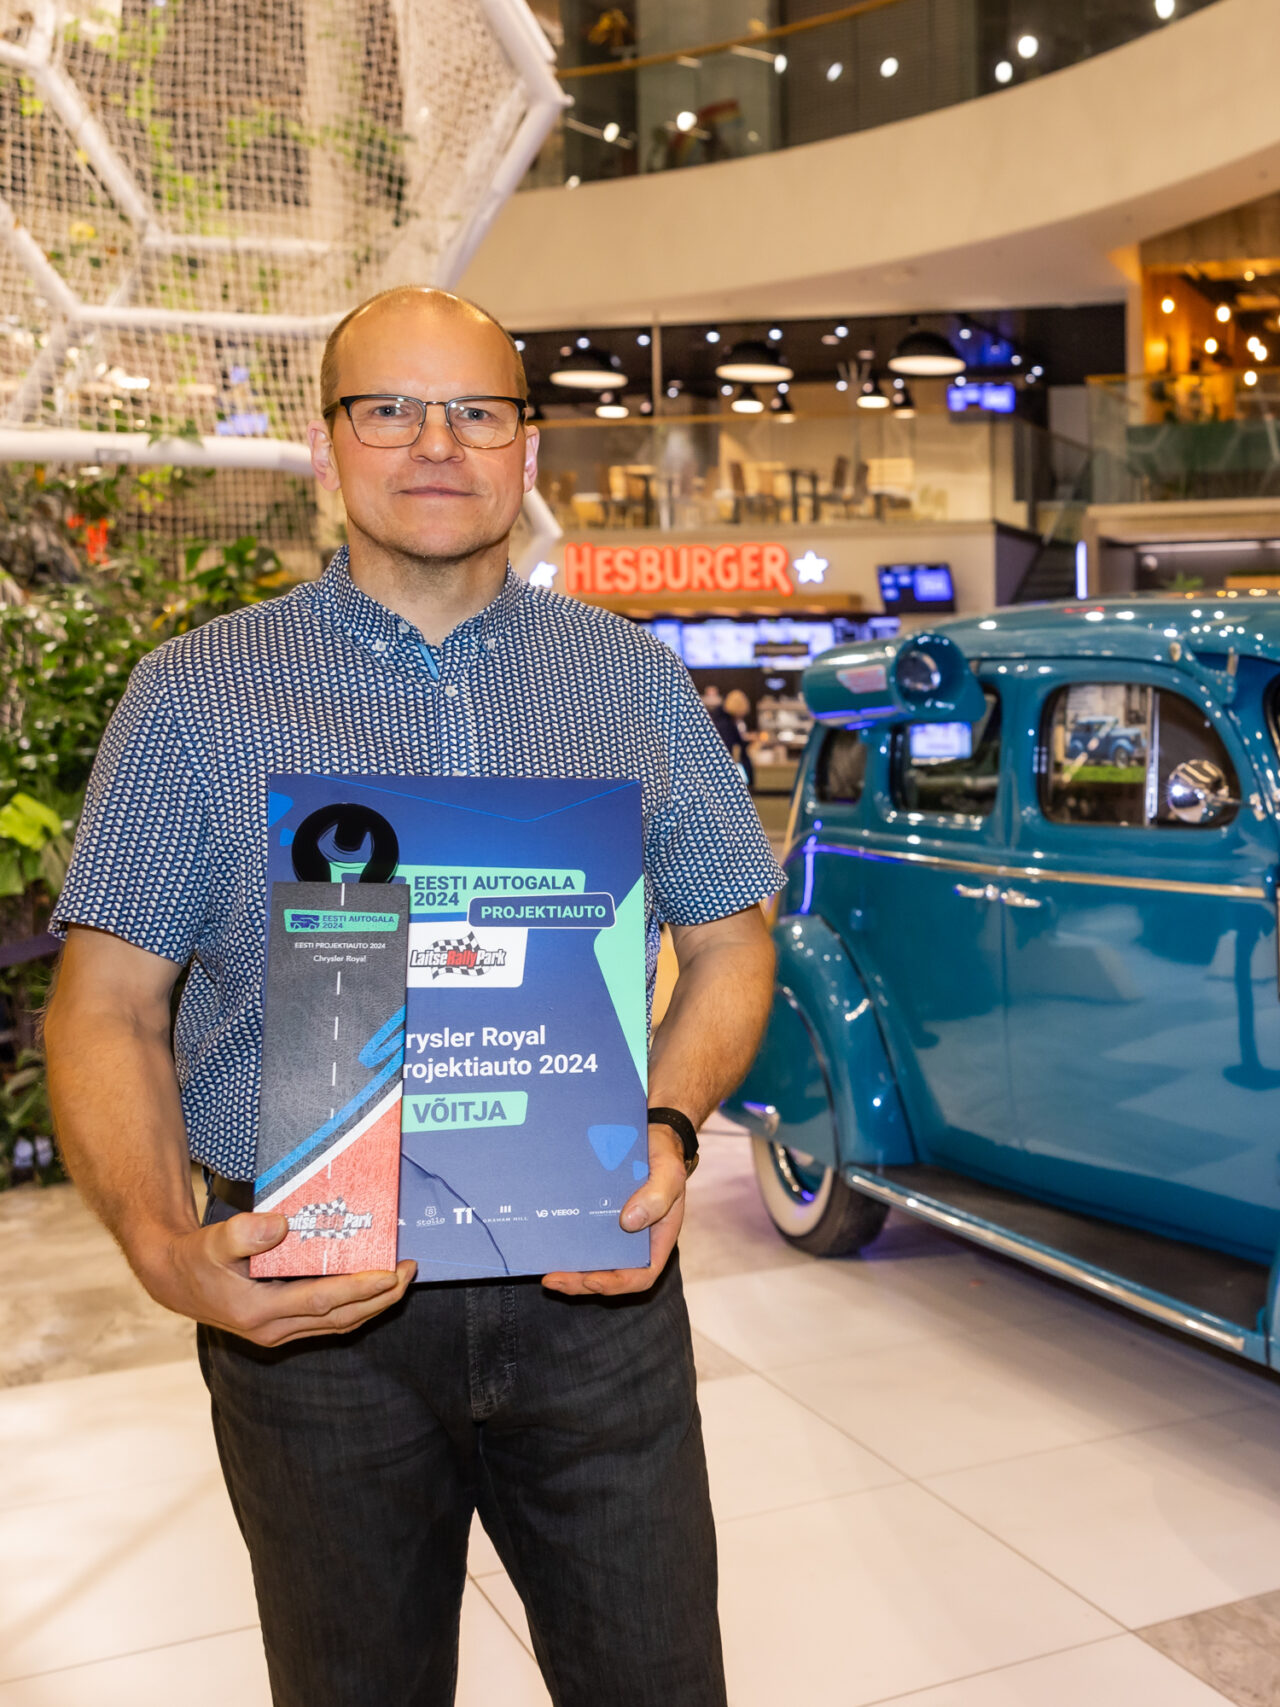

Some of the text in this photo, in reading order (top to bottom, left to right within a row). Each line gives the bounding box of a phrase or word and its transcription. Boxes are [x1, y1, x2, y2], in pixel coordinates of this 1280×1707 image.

[564, 542, 793, 597] HESBURGER
[414, 876, 575, 890] EESTI AUTOGALA
[414, 892, 459, 906] 2024
[348, 915, 395, 923] AUTOGALA
[481, 905, 606, 919] PROJEKTIAUTO
[313, 955, 367, 964] Chrysler Royal
[406, 1025, 546, 1053] rysler Royal
[403, 1053, 599, 1083] rojektiauto 2024
[412, 1097, 508, 1124] VÕITJA
